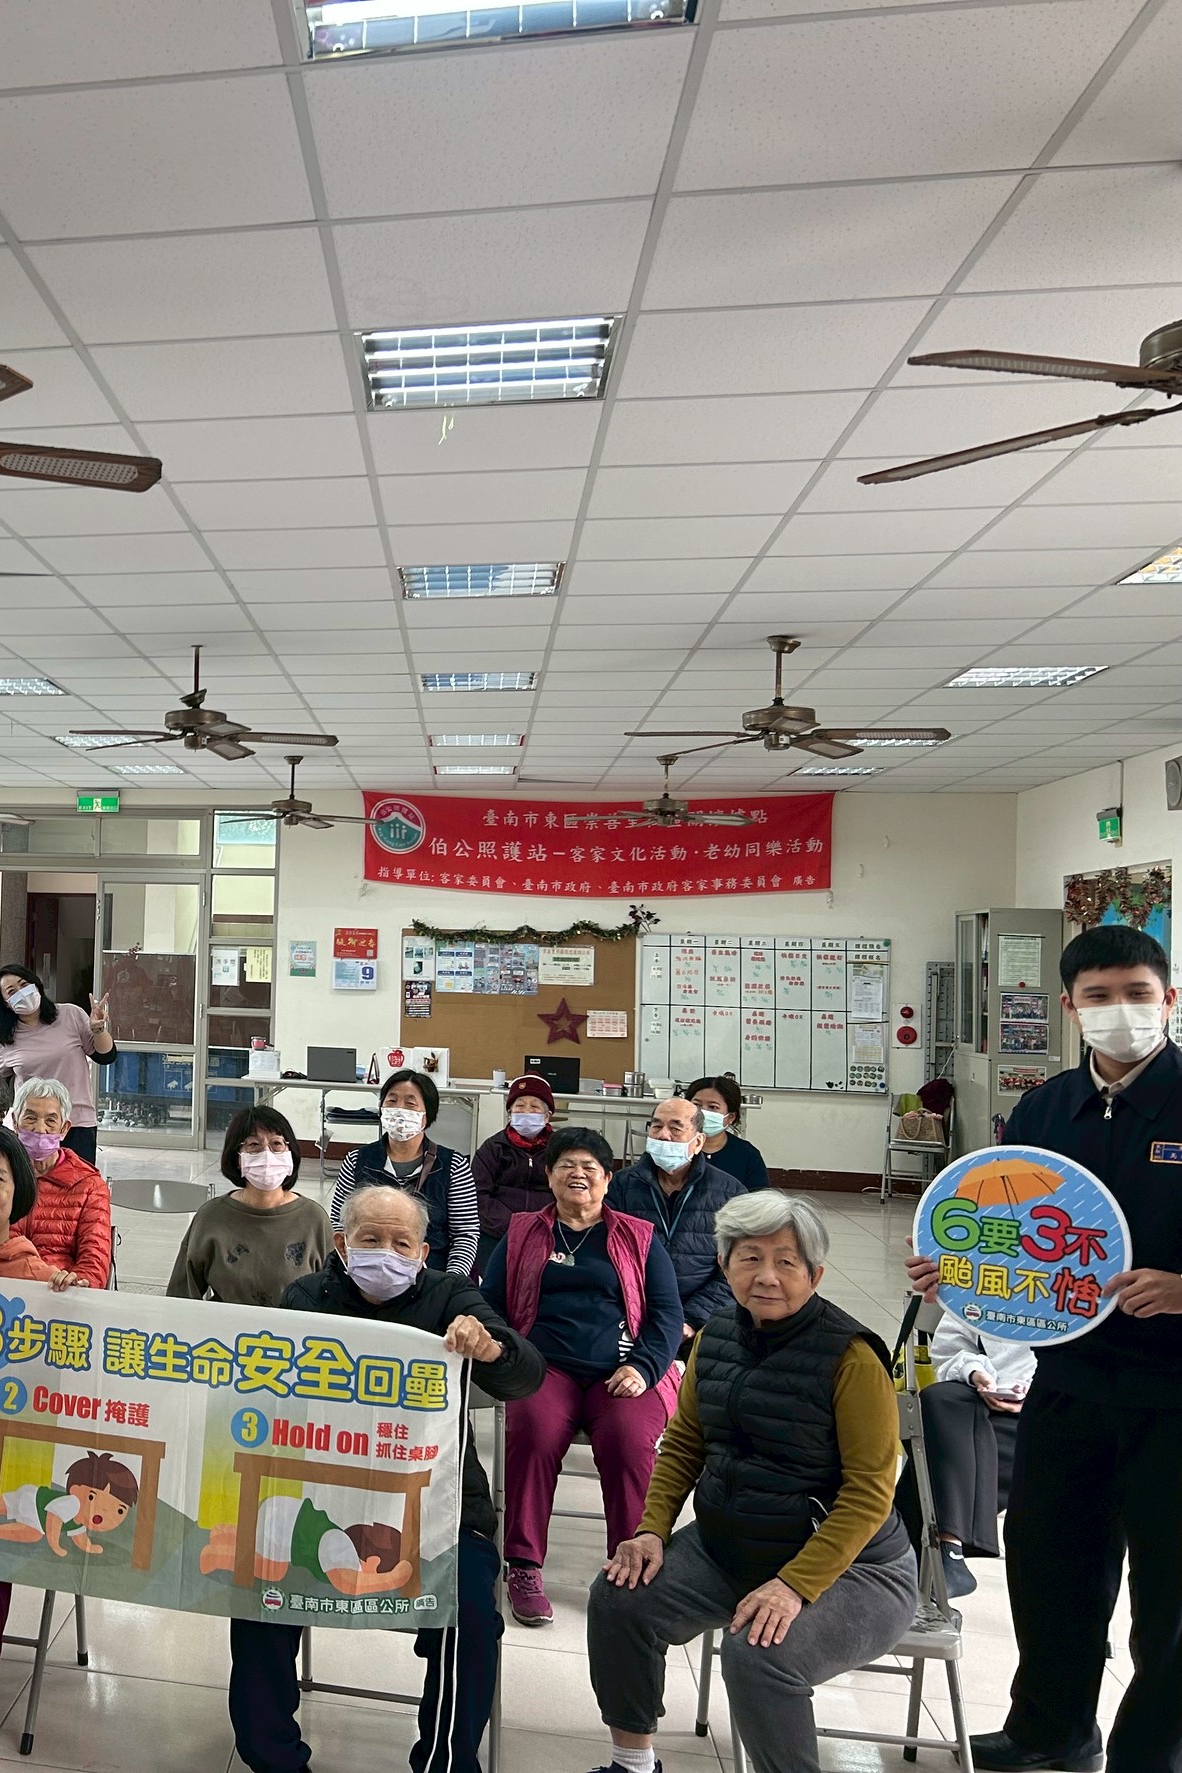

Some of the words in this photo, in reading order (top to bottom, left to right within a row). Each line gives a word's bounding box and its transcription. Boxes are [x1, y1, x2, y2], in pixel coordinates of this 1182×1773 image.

[792, 874, 816, 886] 廣告
[361, 966, 374, 980] 9
[930, 1196, 1109, 1267] 6要3不
[985, 1310, 1069, 1333] 臺南市東區區公所
[103, 1330, 449, 1412] 讓生命安全回壘
[3, 1381, 18, 1410] 2
[32, 1385, 102, 1420] Cover
[104, 1398, 151, 1428] 掩護
[240, 1411, 259, 1443] 3
[271, 1417, 331, 1452] Hold
[337, 1430, 369, 1457] on
[376, 1421, 409, 1441] 穩住
[375, 1441, 439, 1463] 抓住桌腳
[289, 1594, 410, 1615] 臺南市東區區公所
